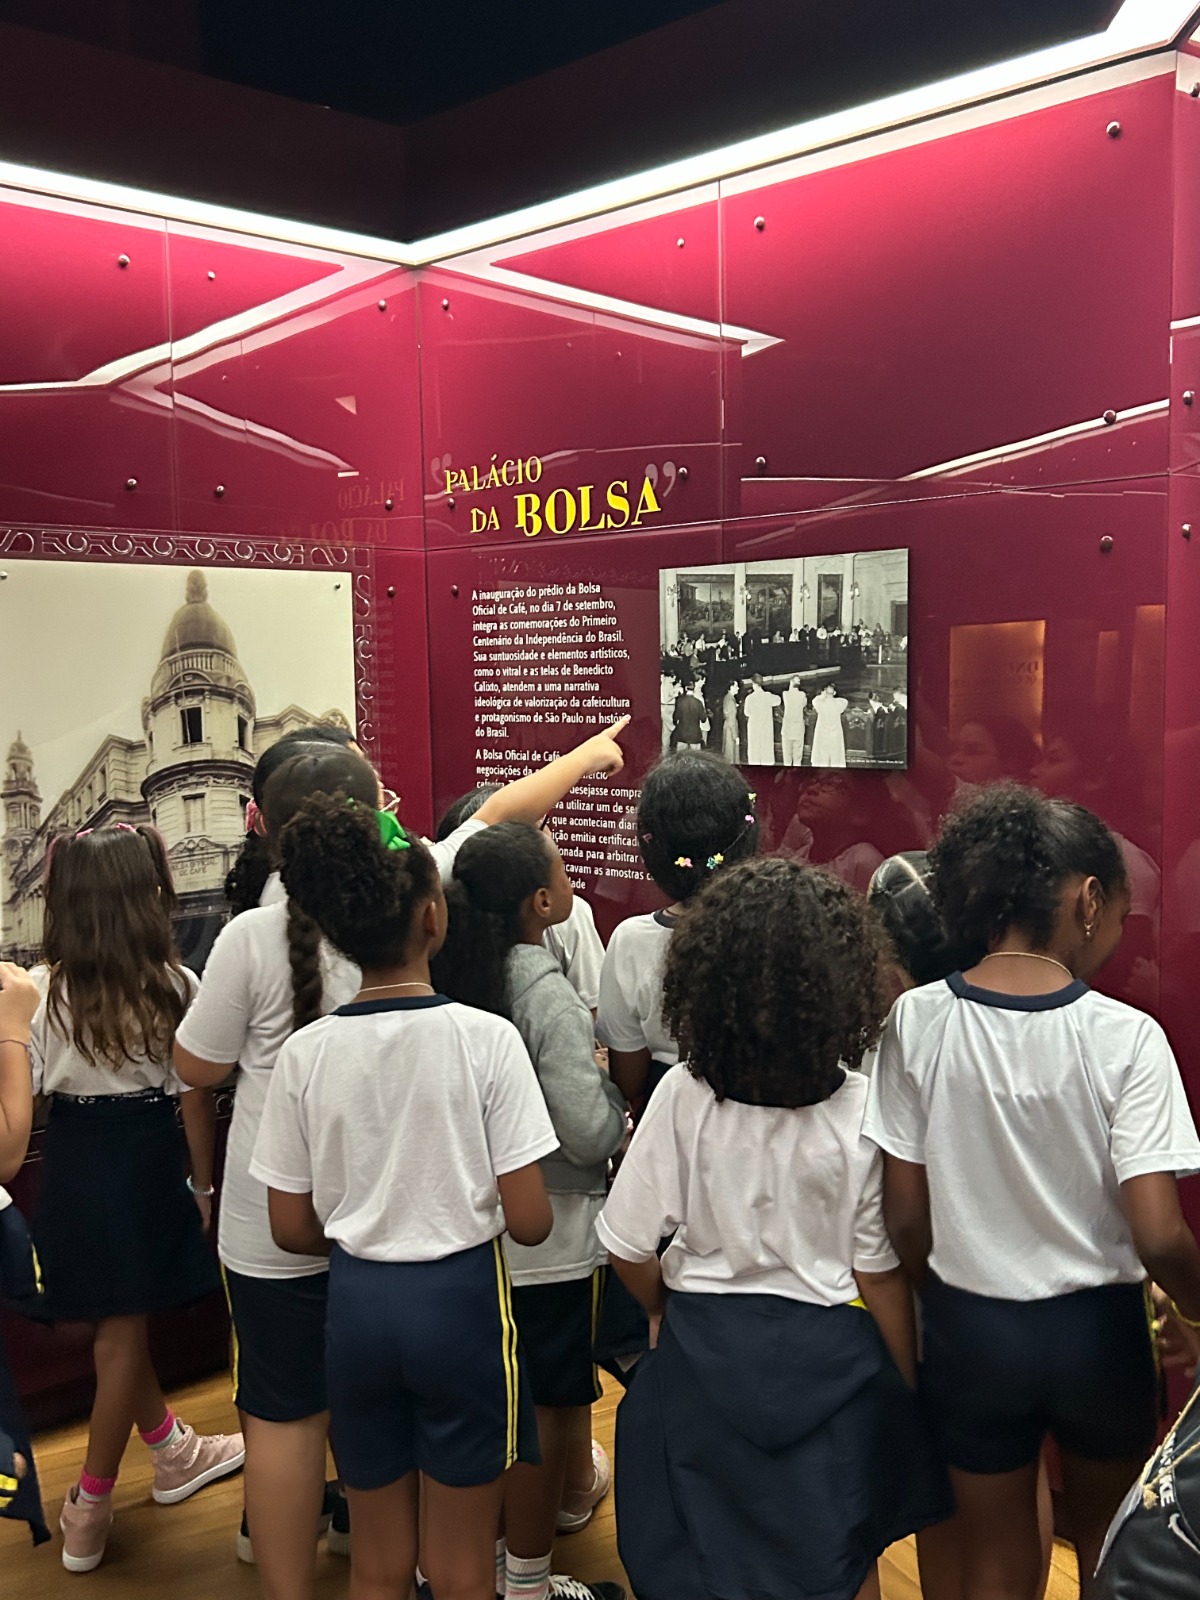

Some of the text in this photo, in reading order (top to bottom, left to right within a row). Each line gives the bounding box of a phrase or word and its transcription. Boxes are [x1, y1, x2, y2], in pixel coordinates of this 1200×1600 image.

[471, 507, 500, 533] DA
[472, 582, 600, 601] A inauguração do prédio da Bolsa
[473, 598, 615, 615] Oficial de Café, no dia 7 de setembro,
[473, 615, 617, 633] integra as comemorações do Primeiro
[473, 630, 624, 647] Centenário da Independência do Brasil.
[474, 648, 629, 662] Sua suntuosidade e elementos artísticos,
[474, 668, 494, 677] como
[496, 668, 501, 676] o
[503, 665, 521, 676] vitral
[530, 667, 538, 676] as
[541, 665, 559, 675] telas
[561, 665, 571, 675] de
[574, 664, 613, 675] Benedicto
[474, 680, 599, 693] Calixto, atendem a uma narrativa
[475, 696, 630, 710] ideológica de valorização da cafeicultura
[475, 714, 479, 722] e
[482, 712, 531, 725] protagonismo
[533, 712, 543, 722] de
[545, 712, 559, 723] São
[562, 712, 583, 723] Paulo
[586, 715, 596, 723] na
[476, 727, 509, 737] do Brasil.
[476, 749, 481, 759] A
[484, 749, 502, 760] Bolsa
[505, 750, 529, 760] Oficial
[532, 751, 541, 761] de
[477, 765, 520, 777] negociações
[523, 766, 533, 776] da
[567, 799, 594, 811] utilizar
[613, 803, 623, 812] de
[552, 816, 567, 826] que
[569, 817, 616, 828] aconteciam
[571, 832, 596, 842] emitia
[599, 834, 640, 847] certificad
[586, 850, 604, 861] para
[607, 851, 638, 863] arbitrar
[594, 867, 603, 875] as
[606, 868, 644, 880] amostras
